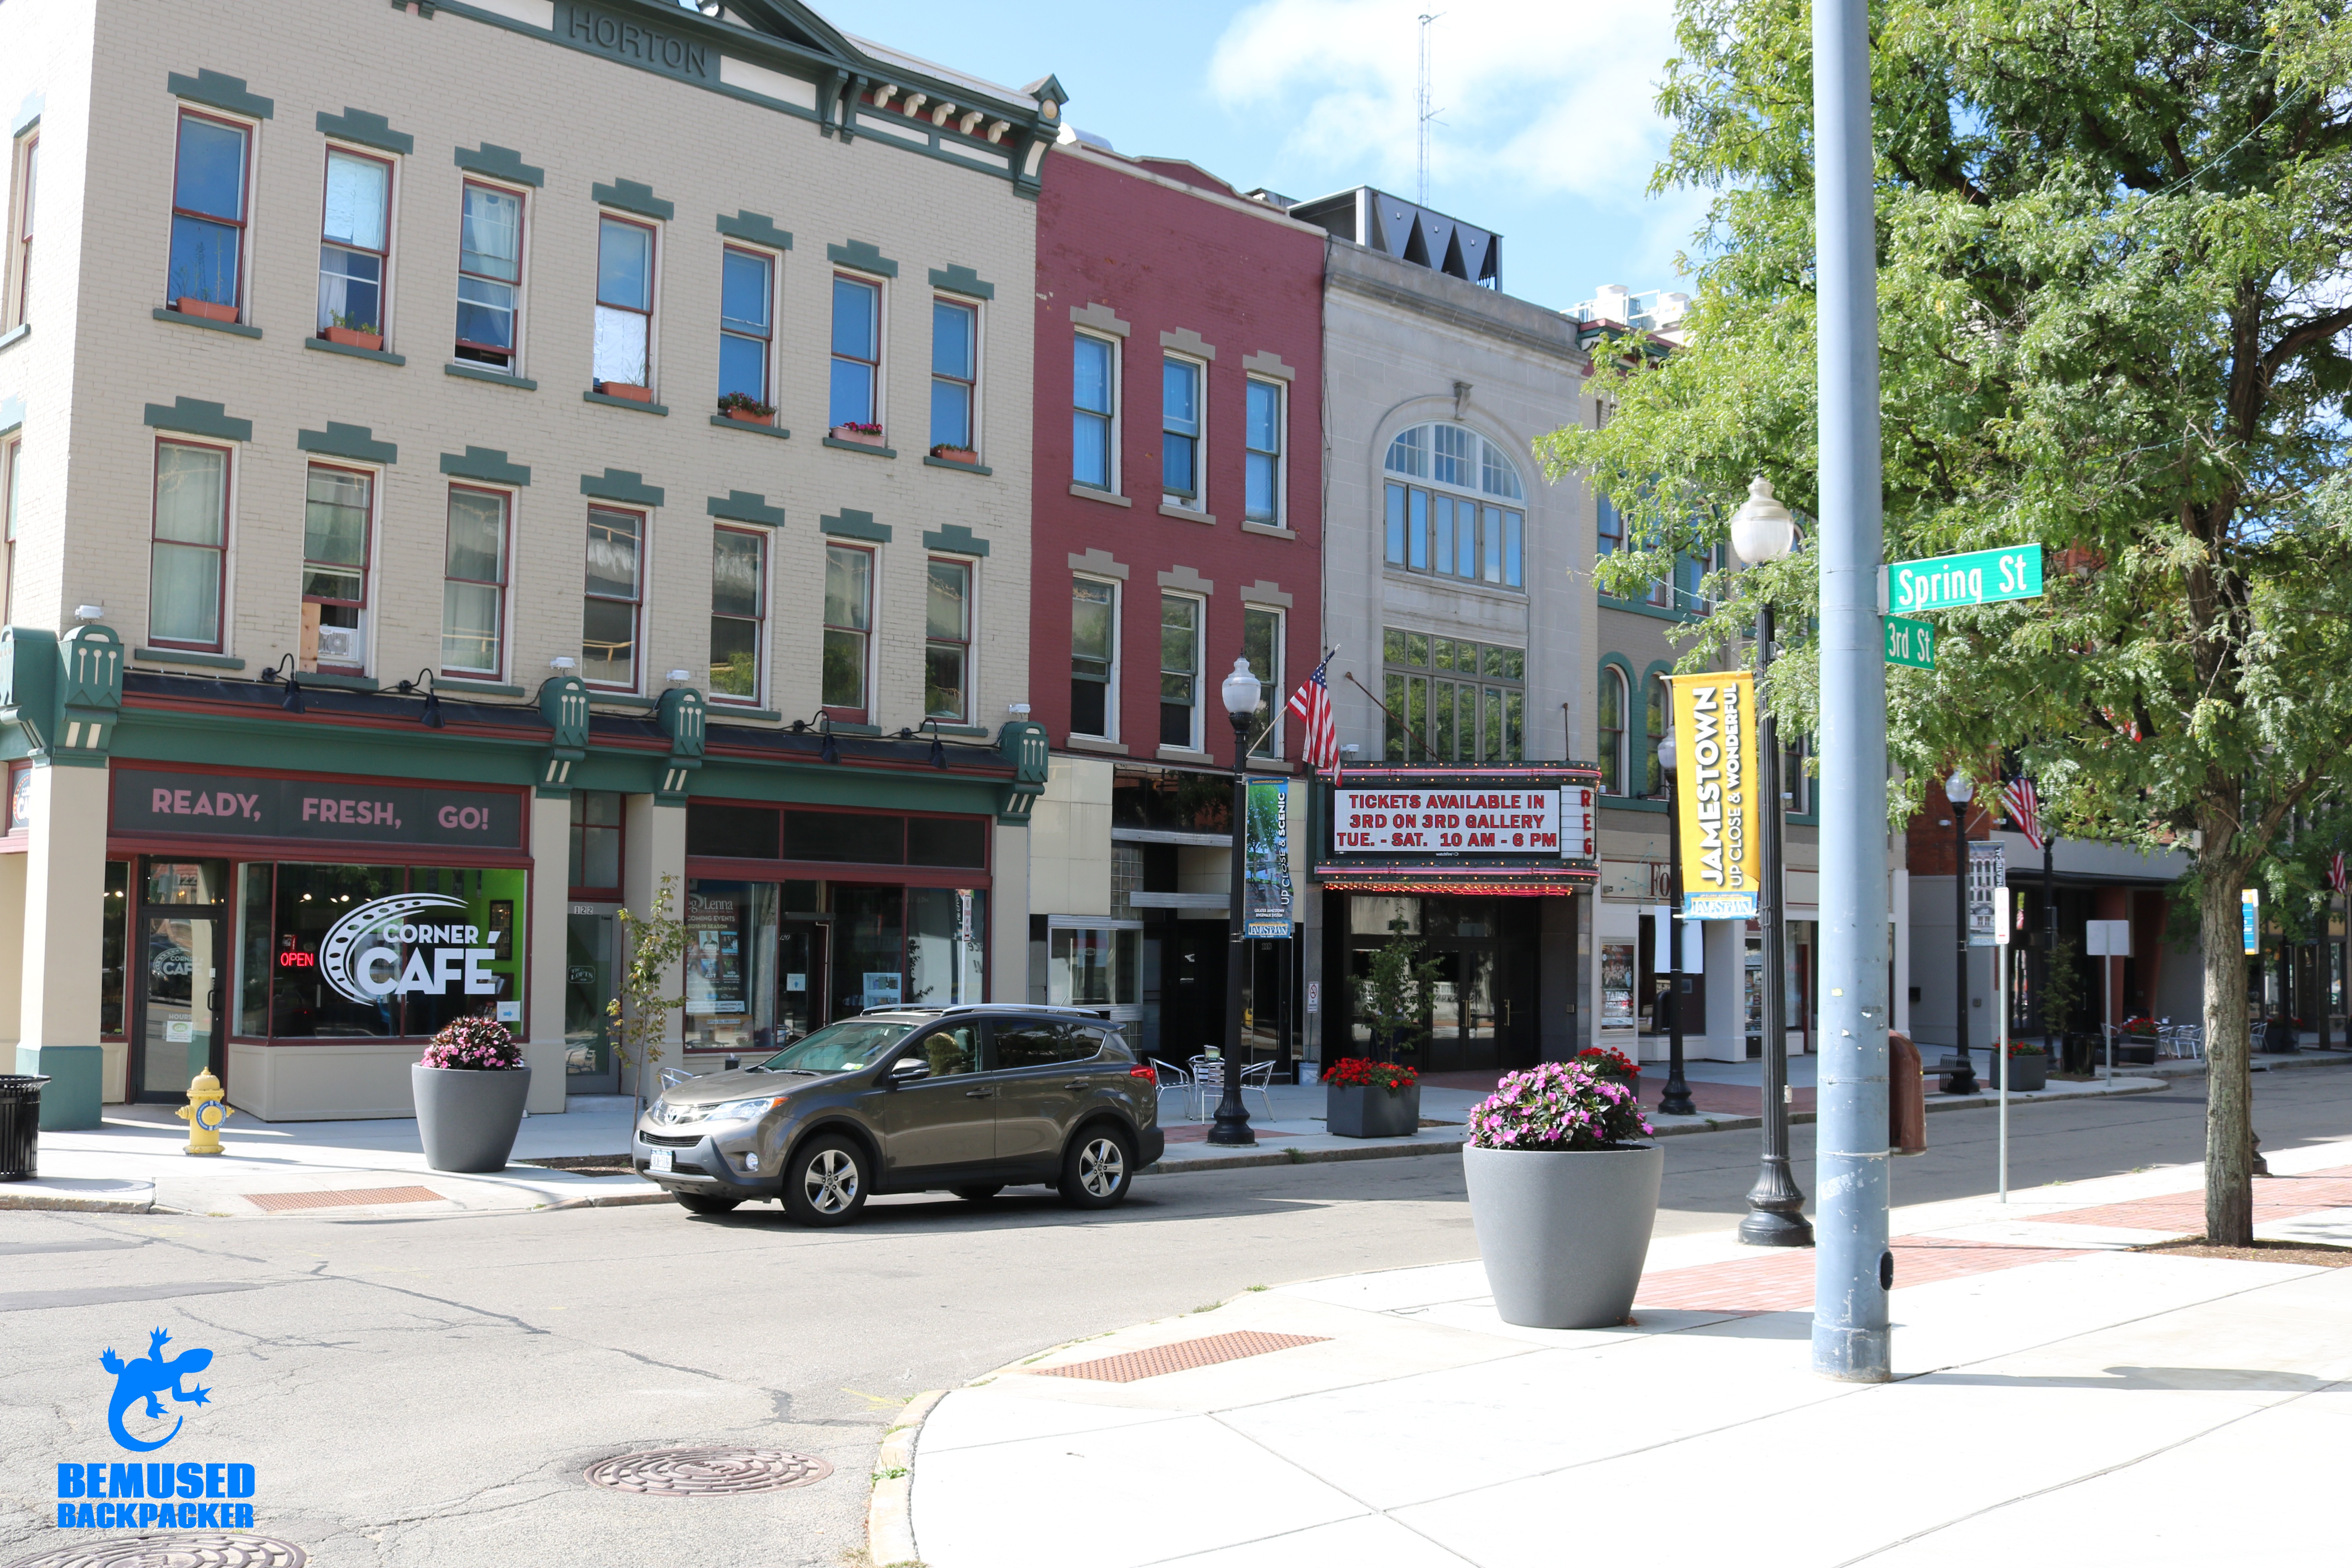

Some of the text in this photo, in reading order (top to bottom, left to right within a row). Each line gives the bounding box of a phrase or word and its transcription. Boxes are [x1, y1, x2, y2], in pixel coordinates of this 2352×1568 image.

[570, 5, 707, 77] HORTON
[1898, 554, 2027, 611] Spring St
[1888, 622, 1931, 662] 3rd St
[1693, 687, 1724, 886] JAMESTOWN
[1723, 682, 1742, 886] UP CLOSE & WONDERFUL
[152, 788, 488, 830] READY, FRESH, GO!
[1349, 795, 1544, 809] TICKETS AVAILABLE IN
[1349, 814, 1545, 829] 3RD ON 3RD GALLERY
[1279, 839, 1285, 847] &
[1337, 833, 1375, 846] TUE.
[1392, 833, 1428, 847] SAT.
[1440, 833, 1462, 847] 10
[1468, 833, 1495, 847] AM
[1513, 833, 1524, 847] 6
[1530, 833, 1557, 847] PM
[1279, 850, 1290, 887] CLOSE
[176, 874, 197, 885] 122
[704, 897, 733, 910] Lenna
[1281, 889, 1290, 905] UP
[1691, 901, 1751, 913] JAMESTOWN
[383, 924, 479, 944] CORNER
[1249, 926, 1286, 935] JAMESTOWN
[280, 952, 314, 966] OPEN
[356, 931, 501, 995] CAFÉ
[571, 972, 593, 980] LOFTS
